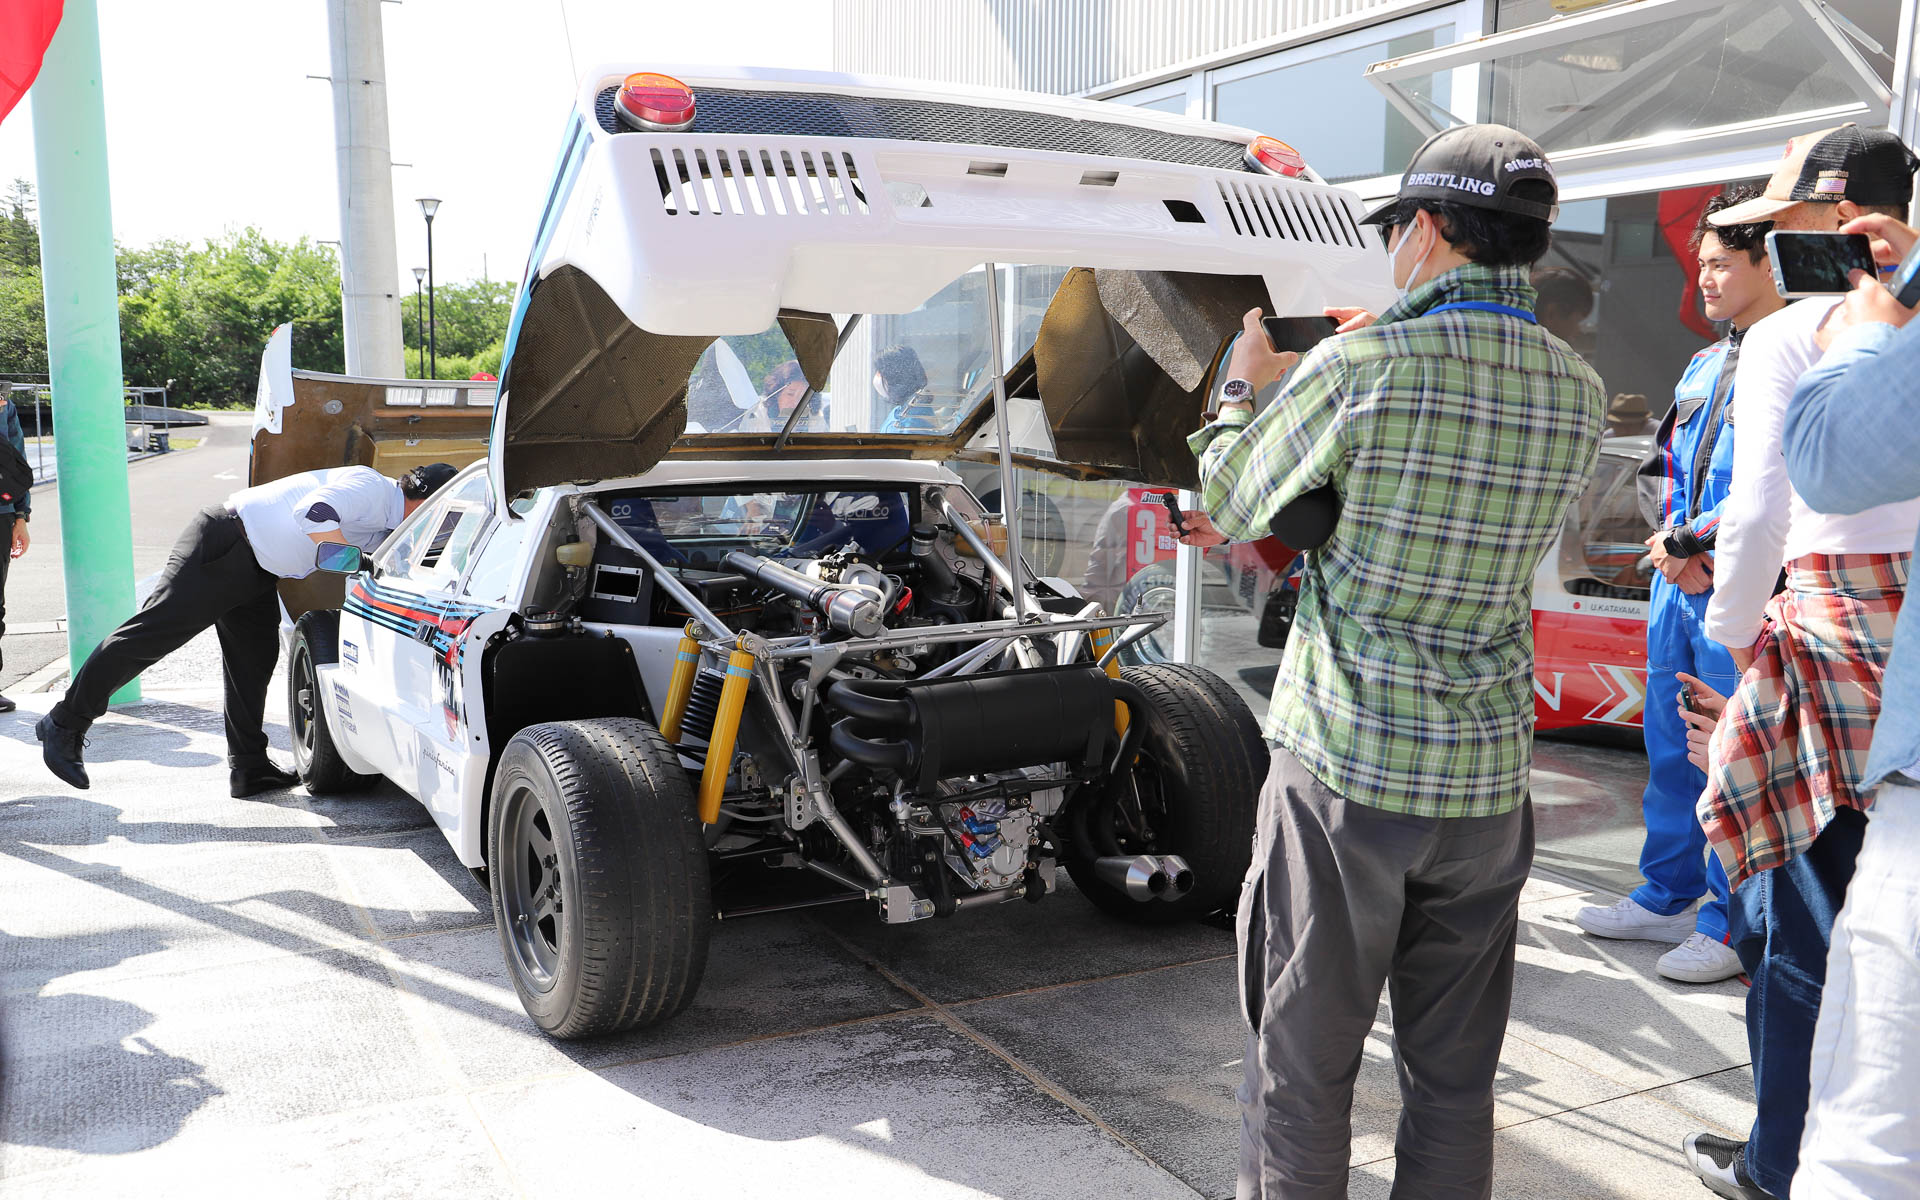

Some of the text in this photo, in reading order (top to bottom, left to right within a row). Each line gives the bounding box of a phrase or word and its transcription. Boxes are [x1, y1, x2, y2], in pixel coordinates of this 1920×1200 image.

[1505, 158, 1543, 172] SINCE
[1407, 173, 1496, 195] BREITLING
[1135, 509, 1156, 566] 3
